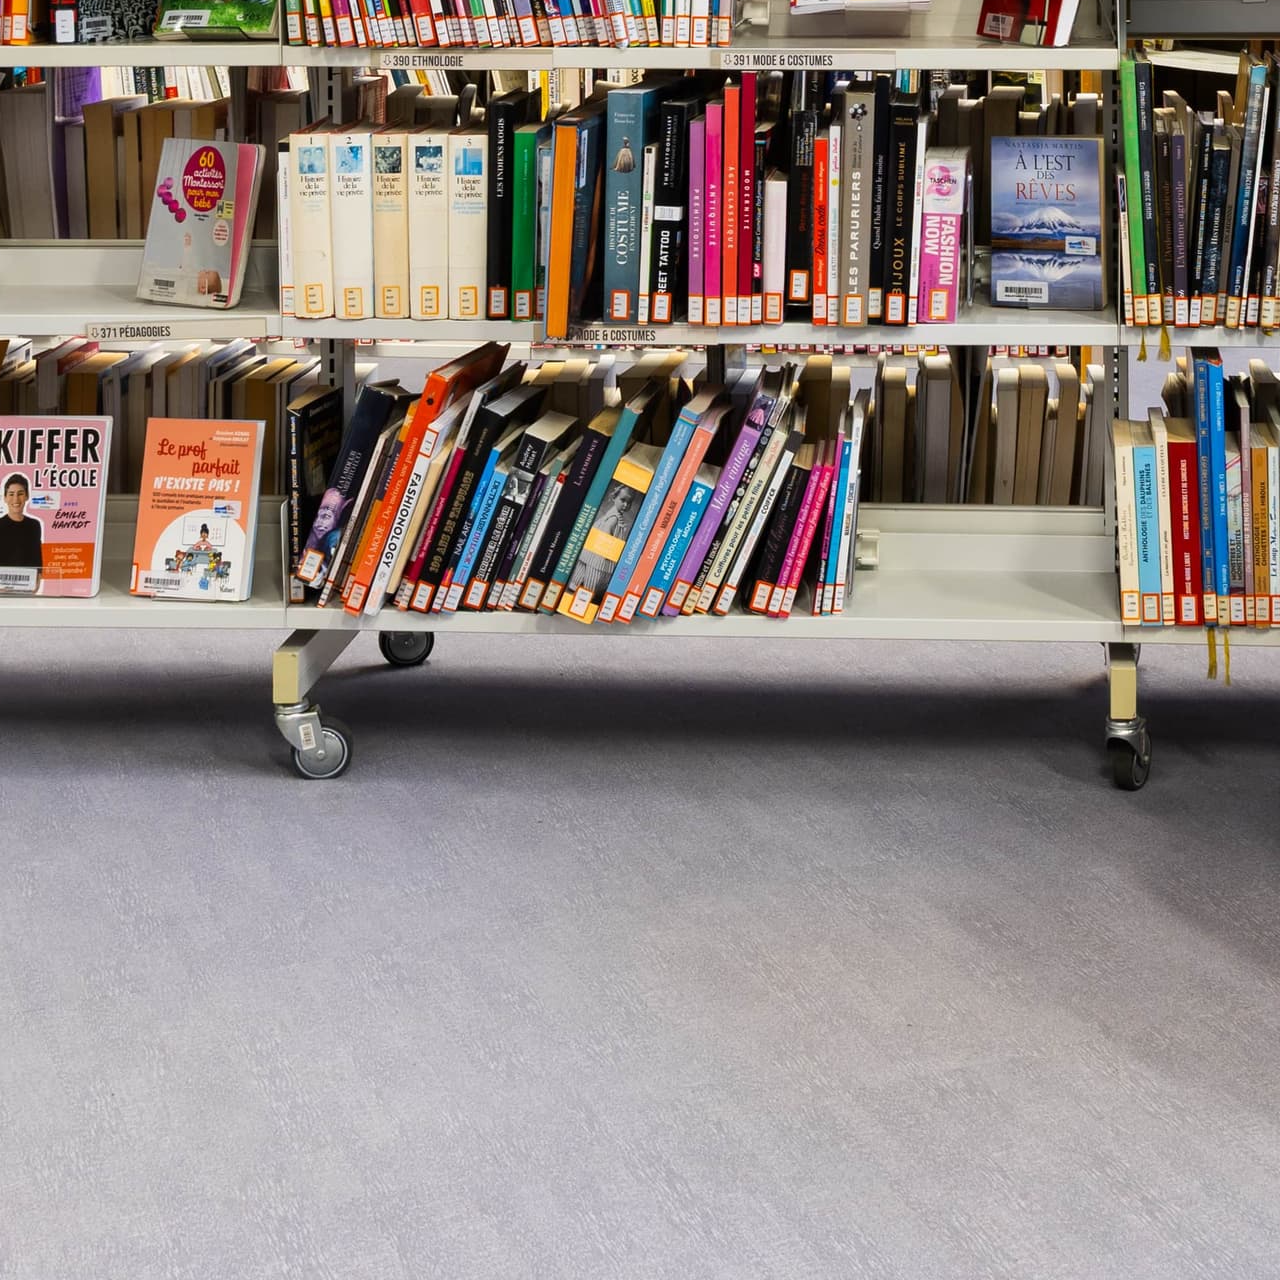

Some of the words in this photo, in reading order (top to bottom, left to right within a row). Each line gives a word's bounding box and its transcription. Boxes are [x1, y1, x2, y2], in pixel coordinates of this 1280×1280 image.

[392, 55, 410, 67] 390
[411, 55, 464, 67] ETHNOLOGIE
[733, 55, 751, 66] 391
[752, 54, 778, 66] MODE
[779, 55, 785, 66] &
[786, 55, 833, 67] COSTUMES
[199, 151, 215, 168] 60
[1033, 154, 1076, 171] L'EST
[183, 175, 224, 190] Montessori
[929, 177, 957, 186] TASCHEN
[1036, 171, 1055, 181] DES
[1015, 177, 1076, 202] RÊVES
[849, 171, 861, 261] PARURIERS
[615, 190, 630, 265] COSTUME
[924, 214, 940, 256] NOW
[659, 230, 671, 268] TATTOO
[939, 215, 956, 286] FASHION
[849, 264, 858, 295] LES
[100, 327, 117, 339] 371
[119, 325, 171, 339] PÉDAGOGIES
[602, 330, 609, 341] &
[610, 330, 656, 342] COSTUMES
[157, 438, 176, 457] Le
[178, 440, 208, 460] prof
[34, 465, 97, 488] L'ÉCOLE
[191, 458, 240, 478] parfait
[153, 476, 205, 491] N'EXISTE
[206, 477, 233, 492] PAS
[54, 508, 87, 521] ÉMILIE
[382, 472, 423, 568] FASHIONOLOGY
[51, 520, 91, 531] HANROT
